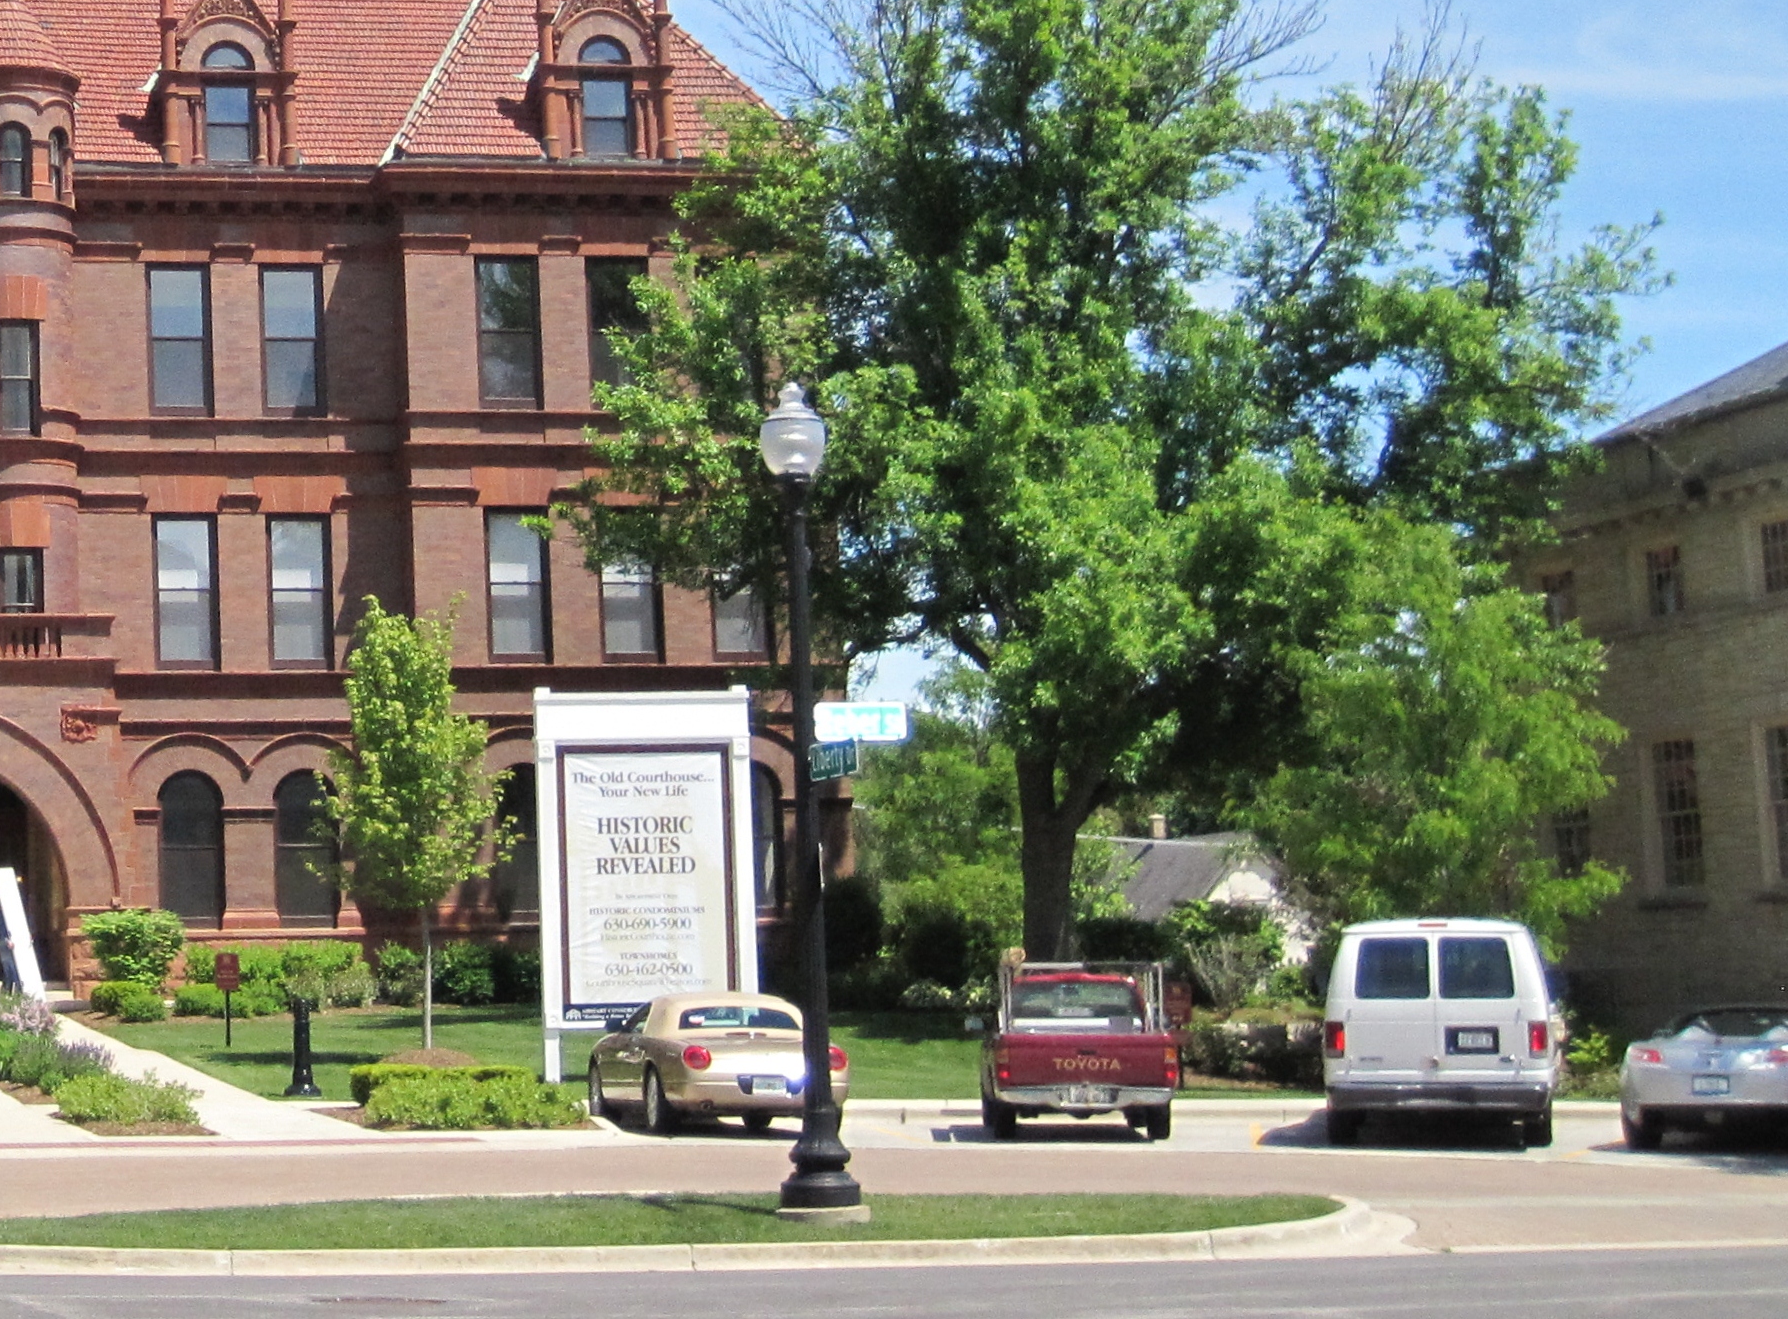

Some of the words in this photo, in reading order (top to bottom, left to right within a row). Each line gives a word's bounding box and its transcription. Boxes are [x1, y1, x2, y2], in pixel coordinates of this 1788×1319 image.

[572, 772, 596, 784] The
[600, 772, 623, 783] Old
[627, 771, 714, 783] Courthouse...
[599, 786, 629, 798] Your
[633, 786, 661, 797] New
[665, 785, 688, 796] Life
[597, 816, 693, 835] HISTORIC
[609, 836, 680, 855] VALUES
[596, 856, 696, 875] REVEALED
[589, 907, 631, 915] HISTORIC
[603, 917, 692, 931] 630-690-5900
[1052, 1057, 1121, 1070] TOYOTA
